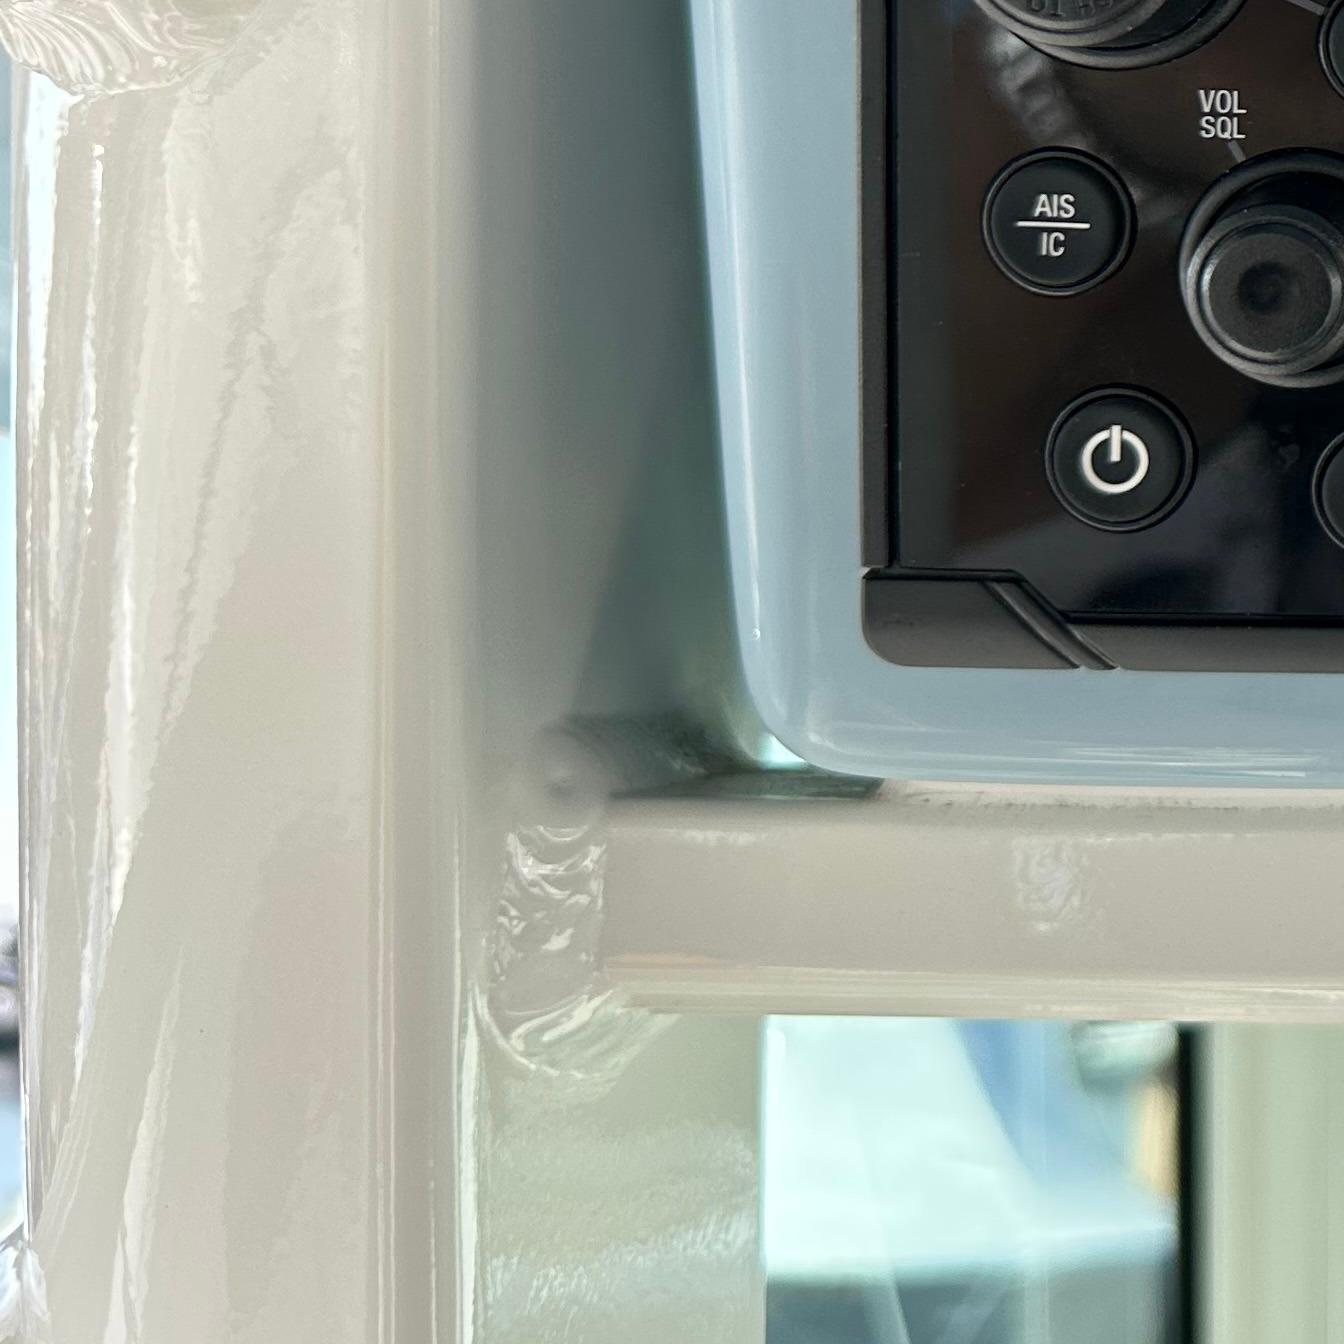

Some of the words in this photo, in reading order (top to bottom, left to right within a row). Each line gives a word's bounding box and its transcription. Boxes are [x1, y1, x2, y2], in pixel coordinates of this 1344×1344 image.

[1198, 89, 1248, 114] VOL
[1199, 115, 1246, 140] SQL
[1033, 193, 1076, 219] AIS
[1041, 231, 1066, 257] IC
